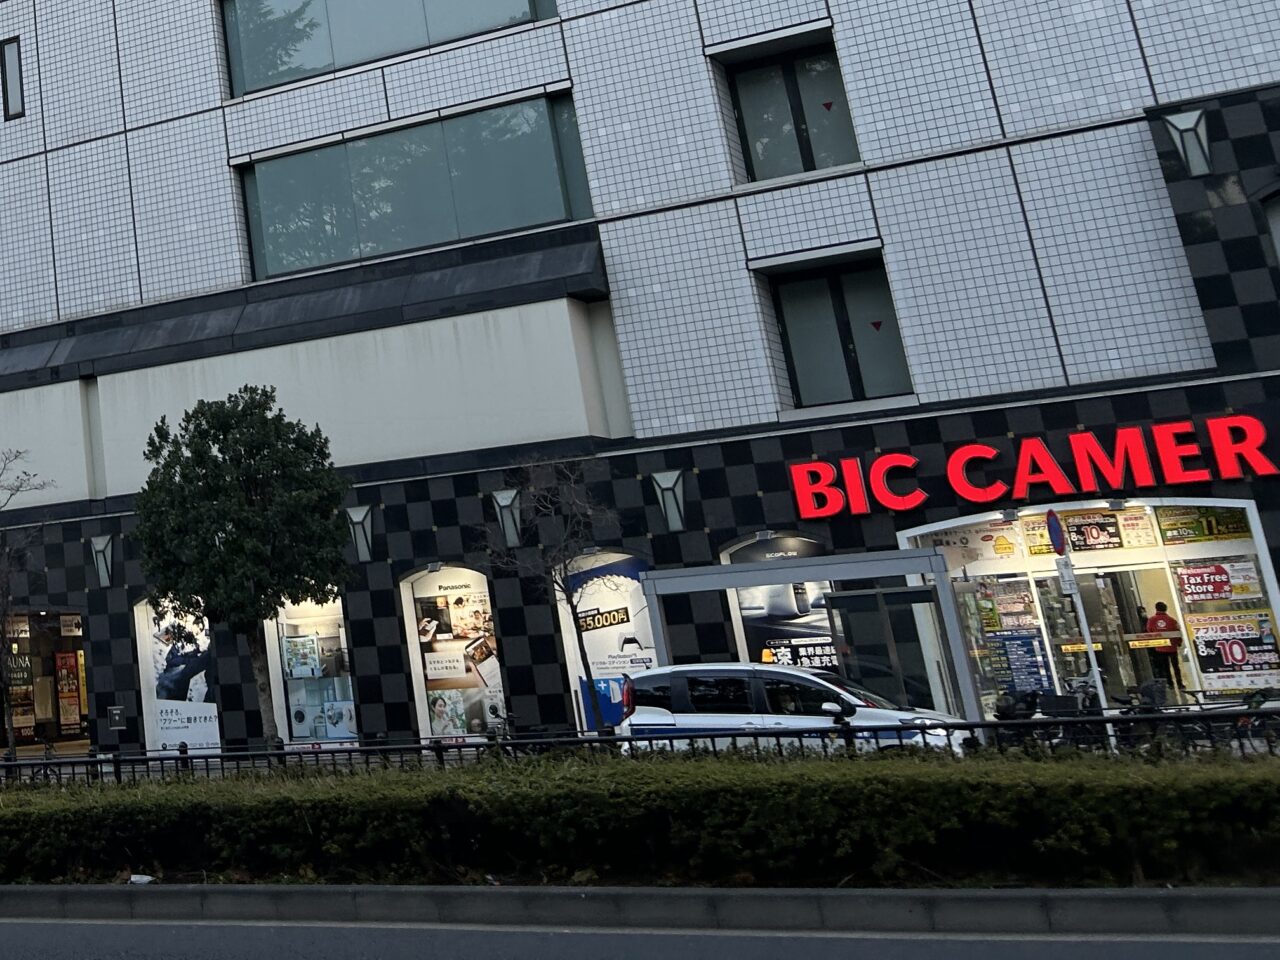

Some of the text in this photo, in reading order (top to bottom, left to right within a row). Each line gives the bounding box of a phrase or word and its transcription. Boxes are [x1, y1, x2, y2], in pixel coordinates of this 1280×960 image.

[790, 453, 929, 520] BIC
[1182, 573, 1228, 584] Tax Free
[438, 583, 471, 591] Panasonic
[1185, 584, 1214, 594] Store
